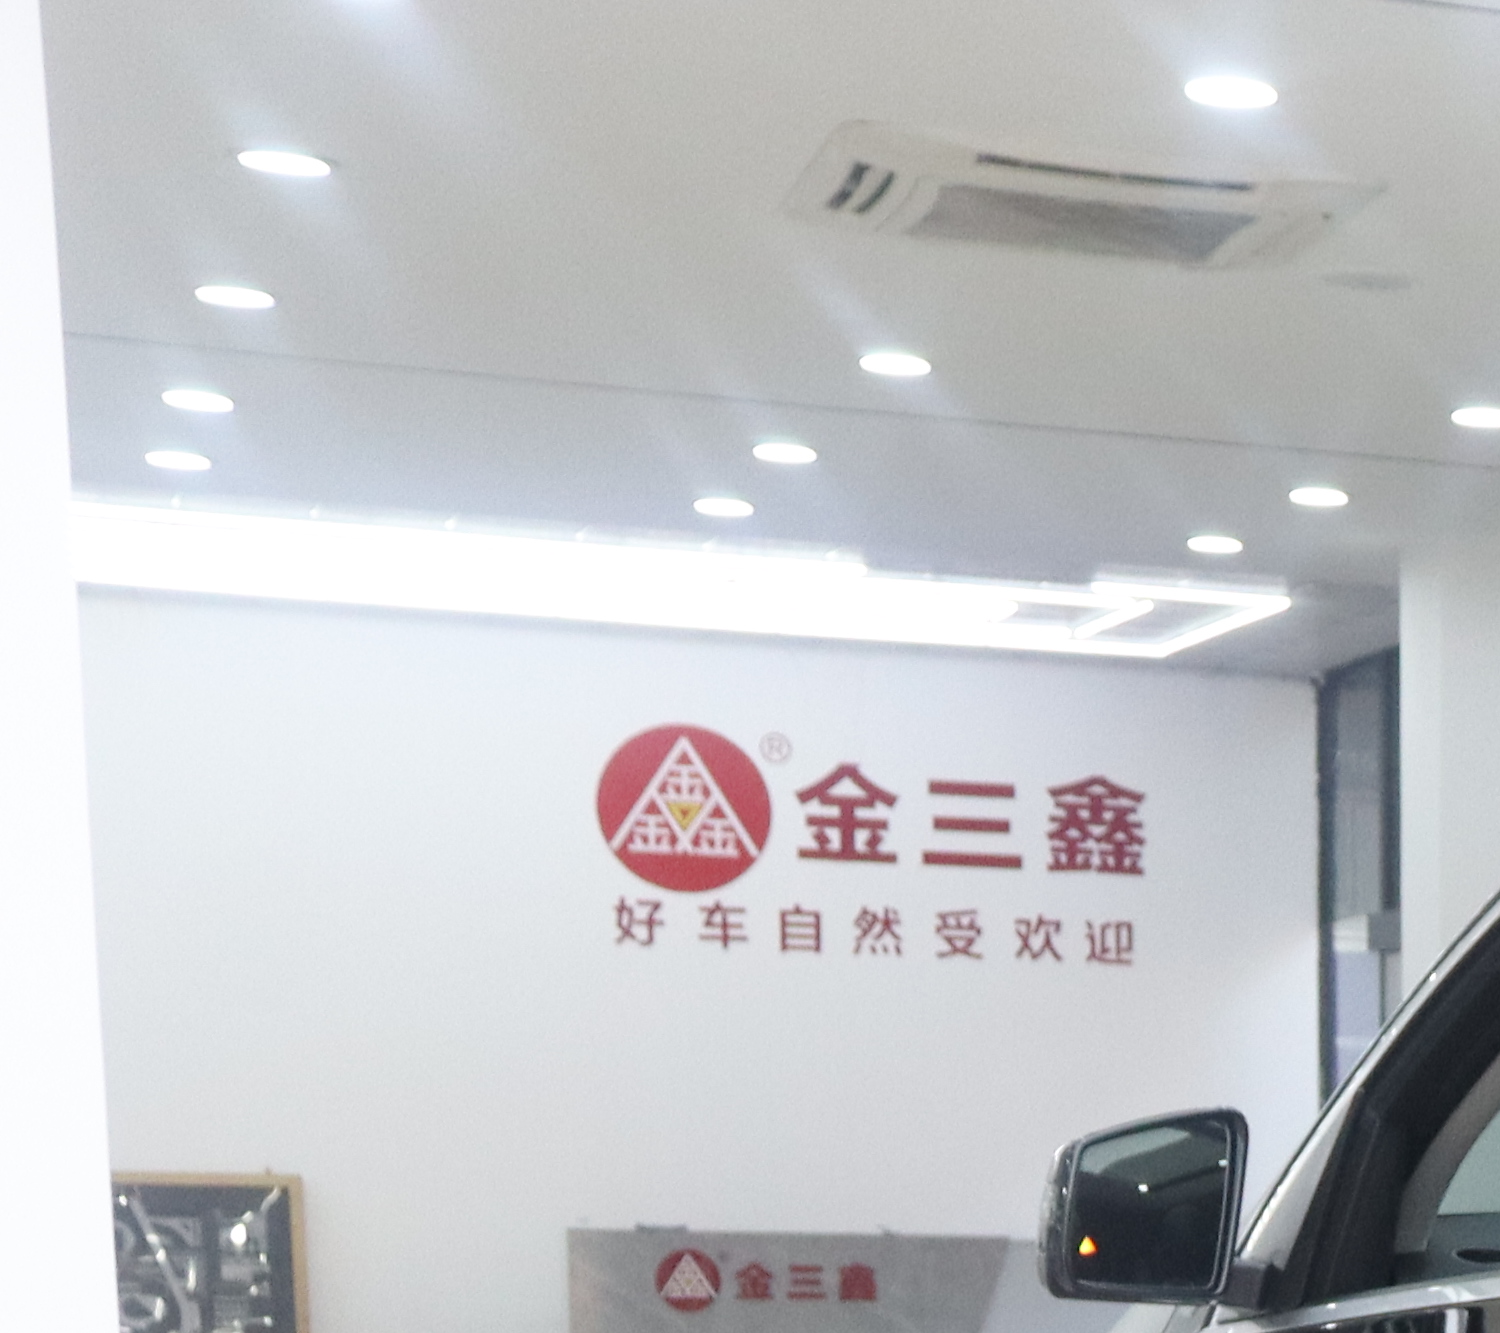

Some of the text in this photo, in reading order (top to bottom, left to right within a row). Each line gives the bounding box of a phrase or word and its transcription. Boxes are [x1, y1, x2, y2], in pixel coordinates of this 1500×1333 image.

[796, 761, 1145, 875] 金三鑫
[613, 896, 1134, 965] 好车自然受欢迎
